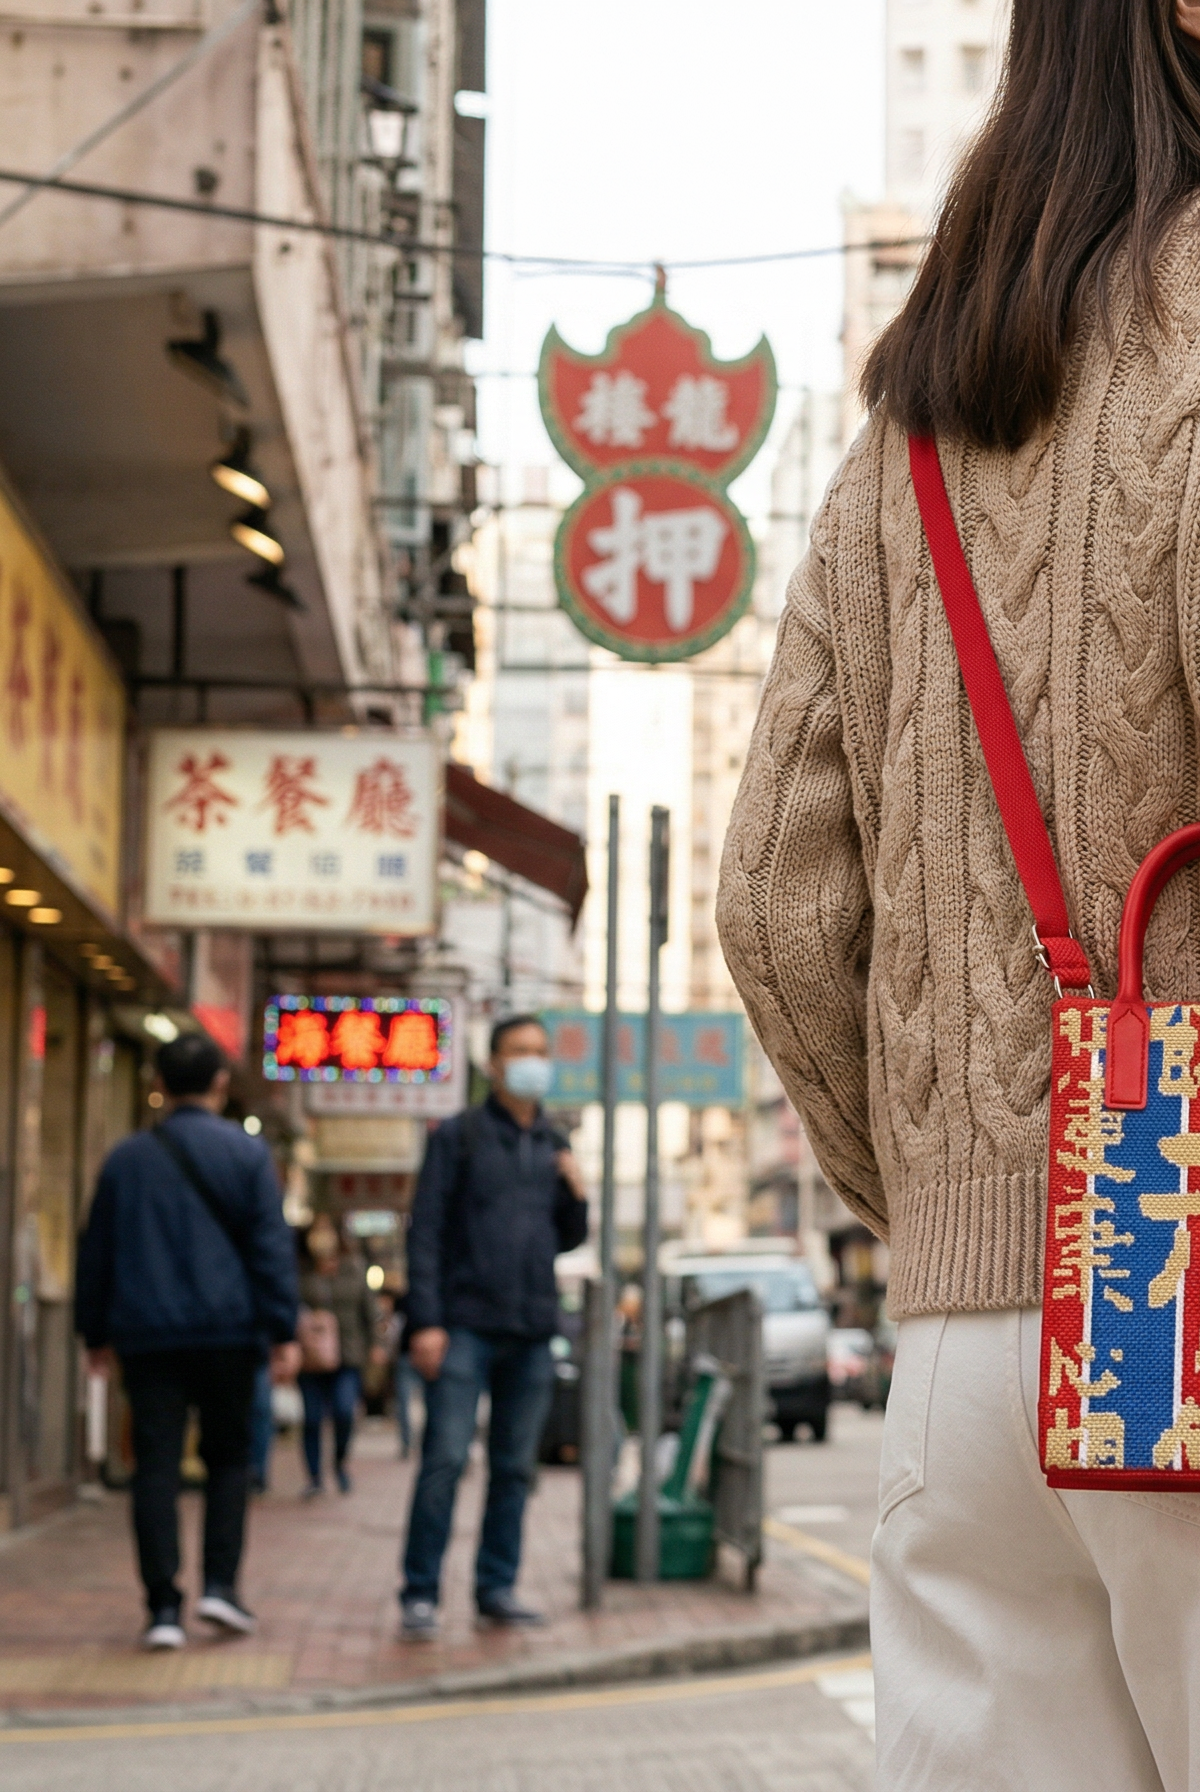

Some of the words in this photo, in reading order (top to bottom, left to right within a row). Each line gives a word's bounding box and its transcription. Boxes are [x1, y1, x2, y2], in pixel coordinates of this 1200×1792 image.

[583, 488, 728, 631] 押
[165, 750, 420, 840] 茶餐廳
